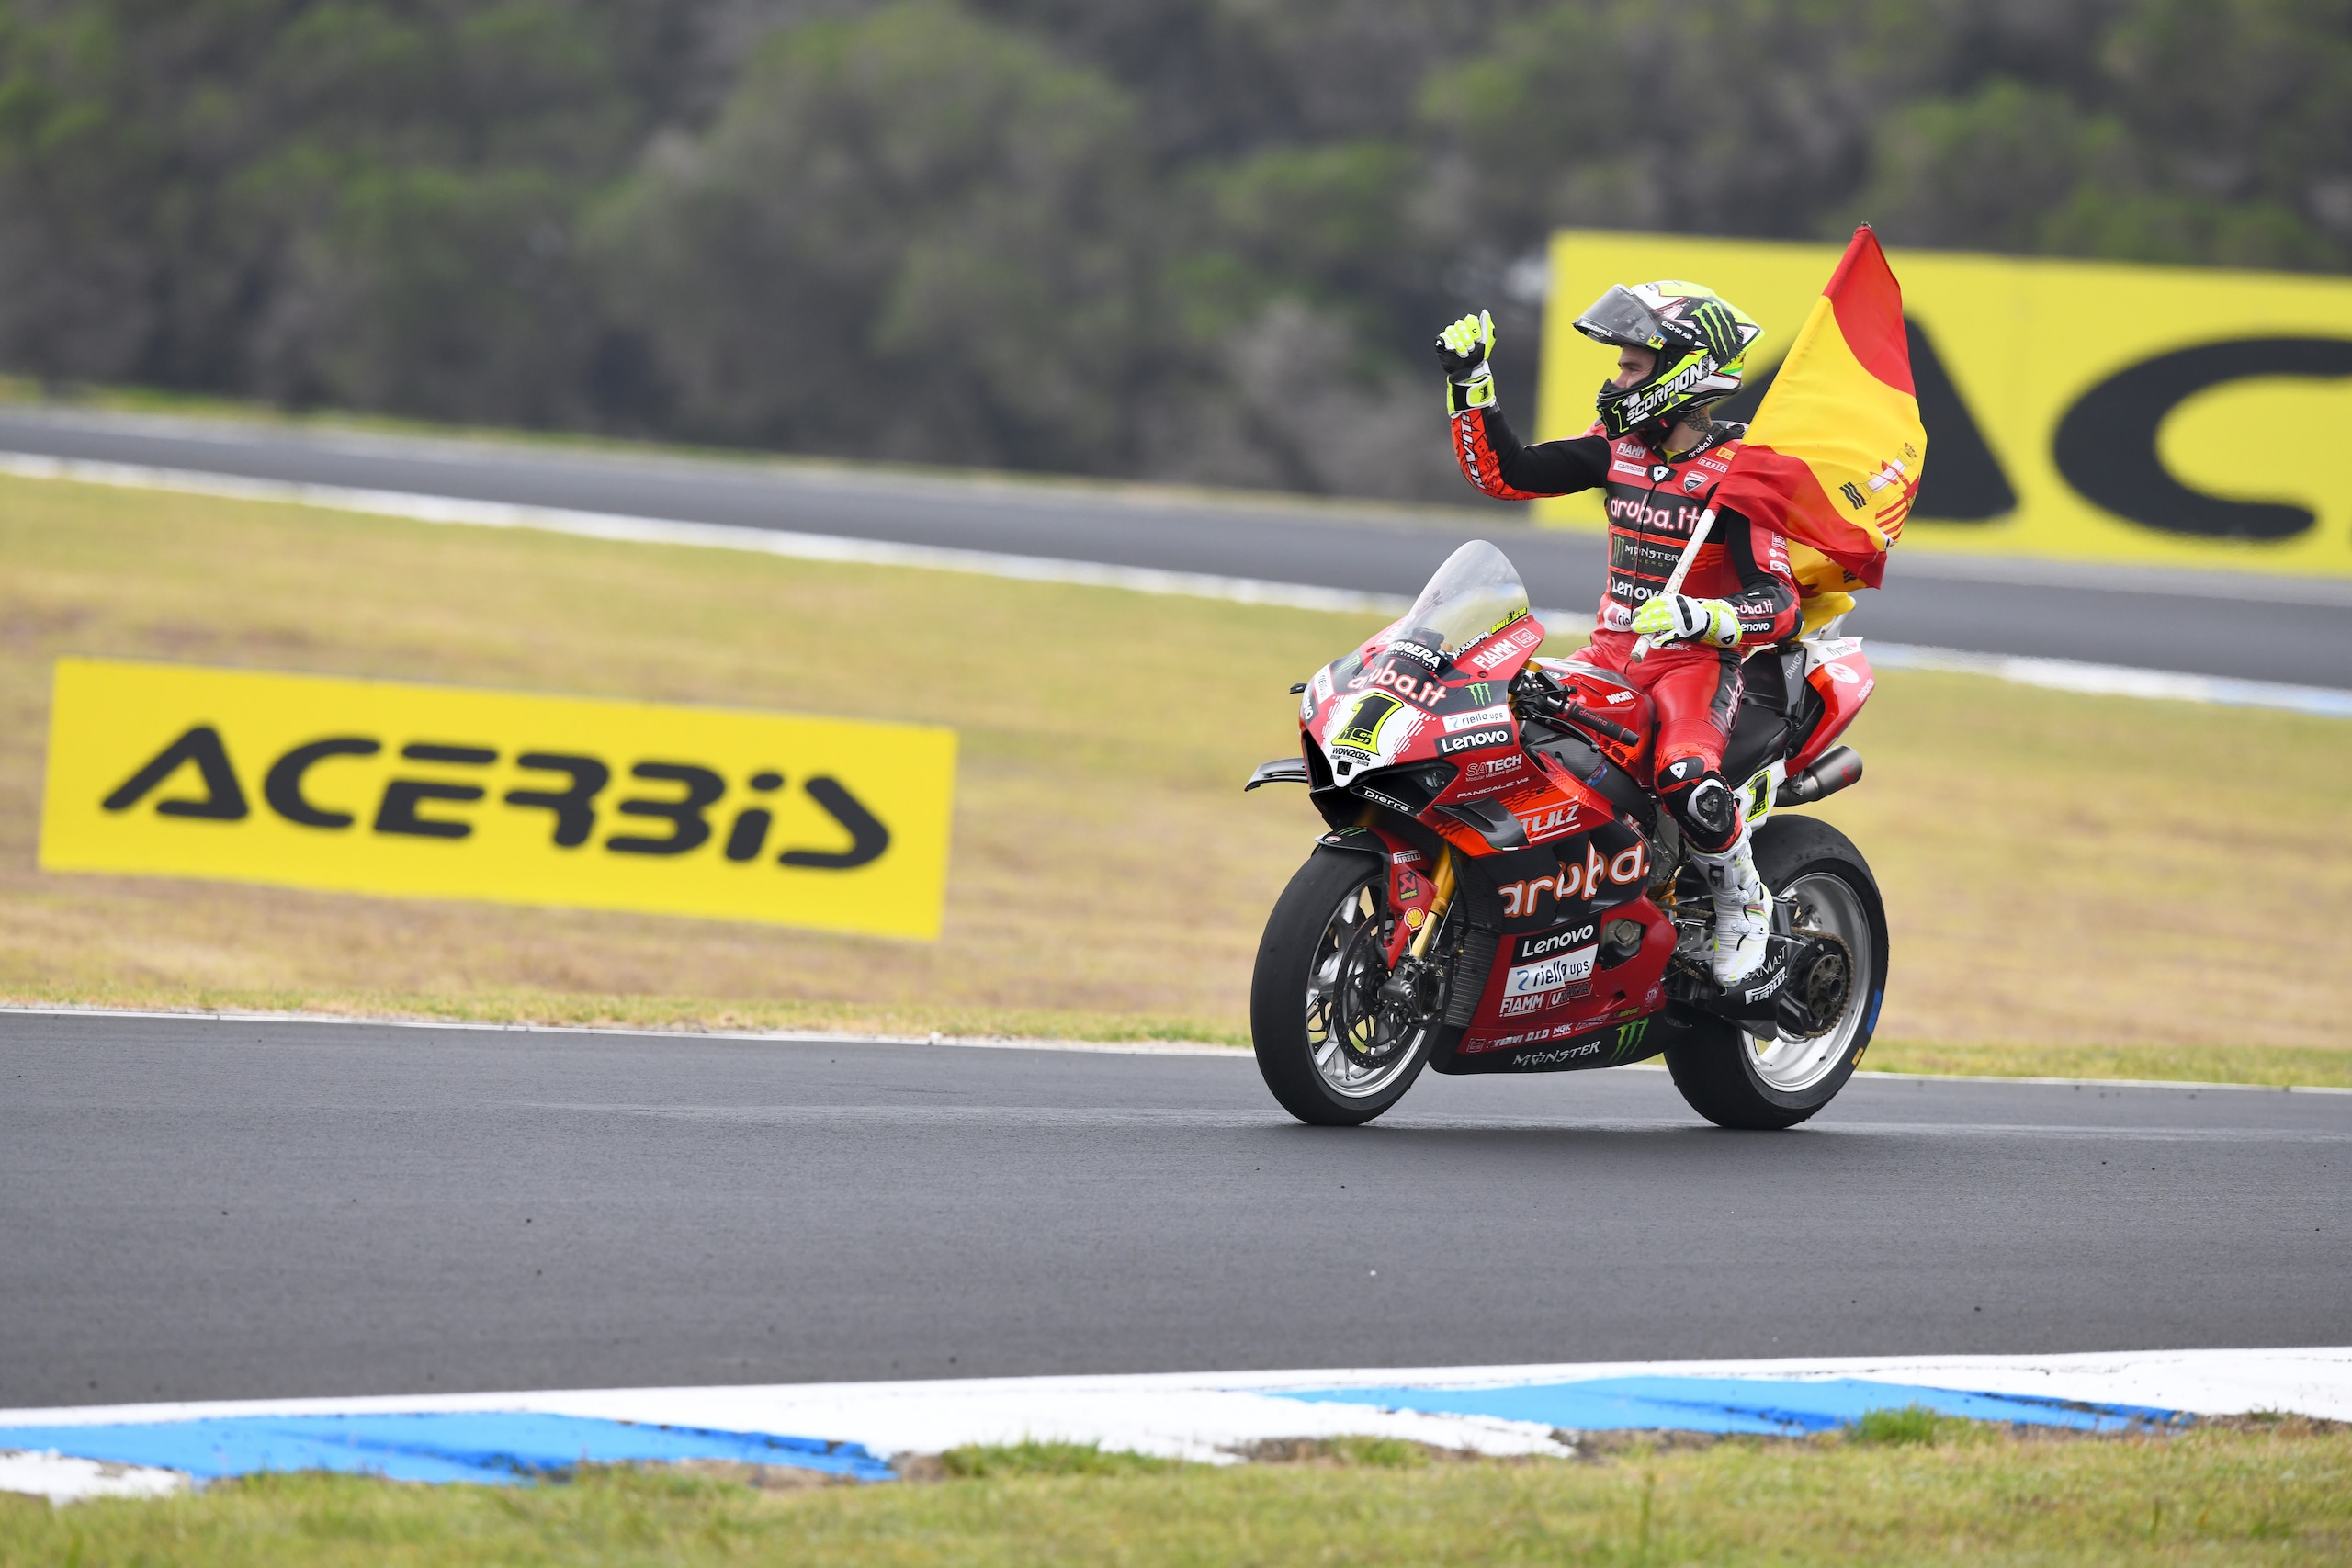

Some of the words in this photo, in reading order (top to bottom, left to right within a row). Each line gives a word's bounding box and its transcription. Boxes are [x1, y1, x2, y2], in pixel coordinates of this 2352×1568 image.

[1626, 355, 1704, 422] SCORPION
[1616, 442, 1647, 459] FIAMM
[1688, 434, 1714, 458] aruba.it
[1617, 463, 1644, 473] CARRERA
[1611, 491, 1701, 535] aruba.it
[1624, 545, 1680, 563] MONSTER
[1611, 576, 1662, 600] Lenov
[1734, 599, 1774, 615] ruba.it
[1741, 622, 1770, 632] enovo
[1470, 639, 1521, 671] FIAMM
[1784, 653, 1804, 680] DAMAST
[1606, 690, 1634, 705] DUCATI
[1331, 692, 1404, 756] 1
[1462, 712, 1488, 726] riello
[1489, 711, 1504, 721] ups
[1578, 709, 1609, 727] domino
[1441, 730, 1509, 753] Lenovo
[1332, 747, 1371, 761] WDW2024
[1465, 753, 1522, 776] SATECH
[1485, 770, 1505, 779] Machine
[1363, 789, 1409, 812] Dierre
[1456, 781, 1515, 799] PANIGALE
[1520, 804, 1580, 832] TULZ
[1392, 849, 1421, 865] PIRELLI
[1521, 924, 1594, 958] Lenovo
[1533, 960, 1567, 987] riello
[1570, 960, 1589, 977] ups
[1745, 965, 1786, 1006] PIRELLI
[1498, 994, 1544, 1017] FIAMM
[1553, 1022, 1573, 1034] NGK
[1512, 1040, 1601, 1067] MONSTER
